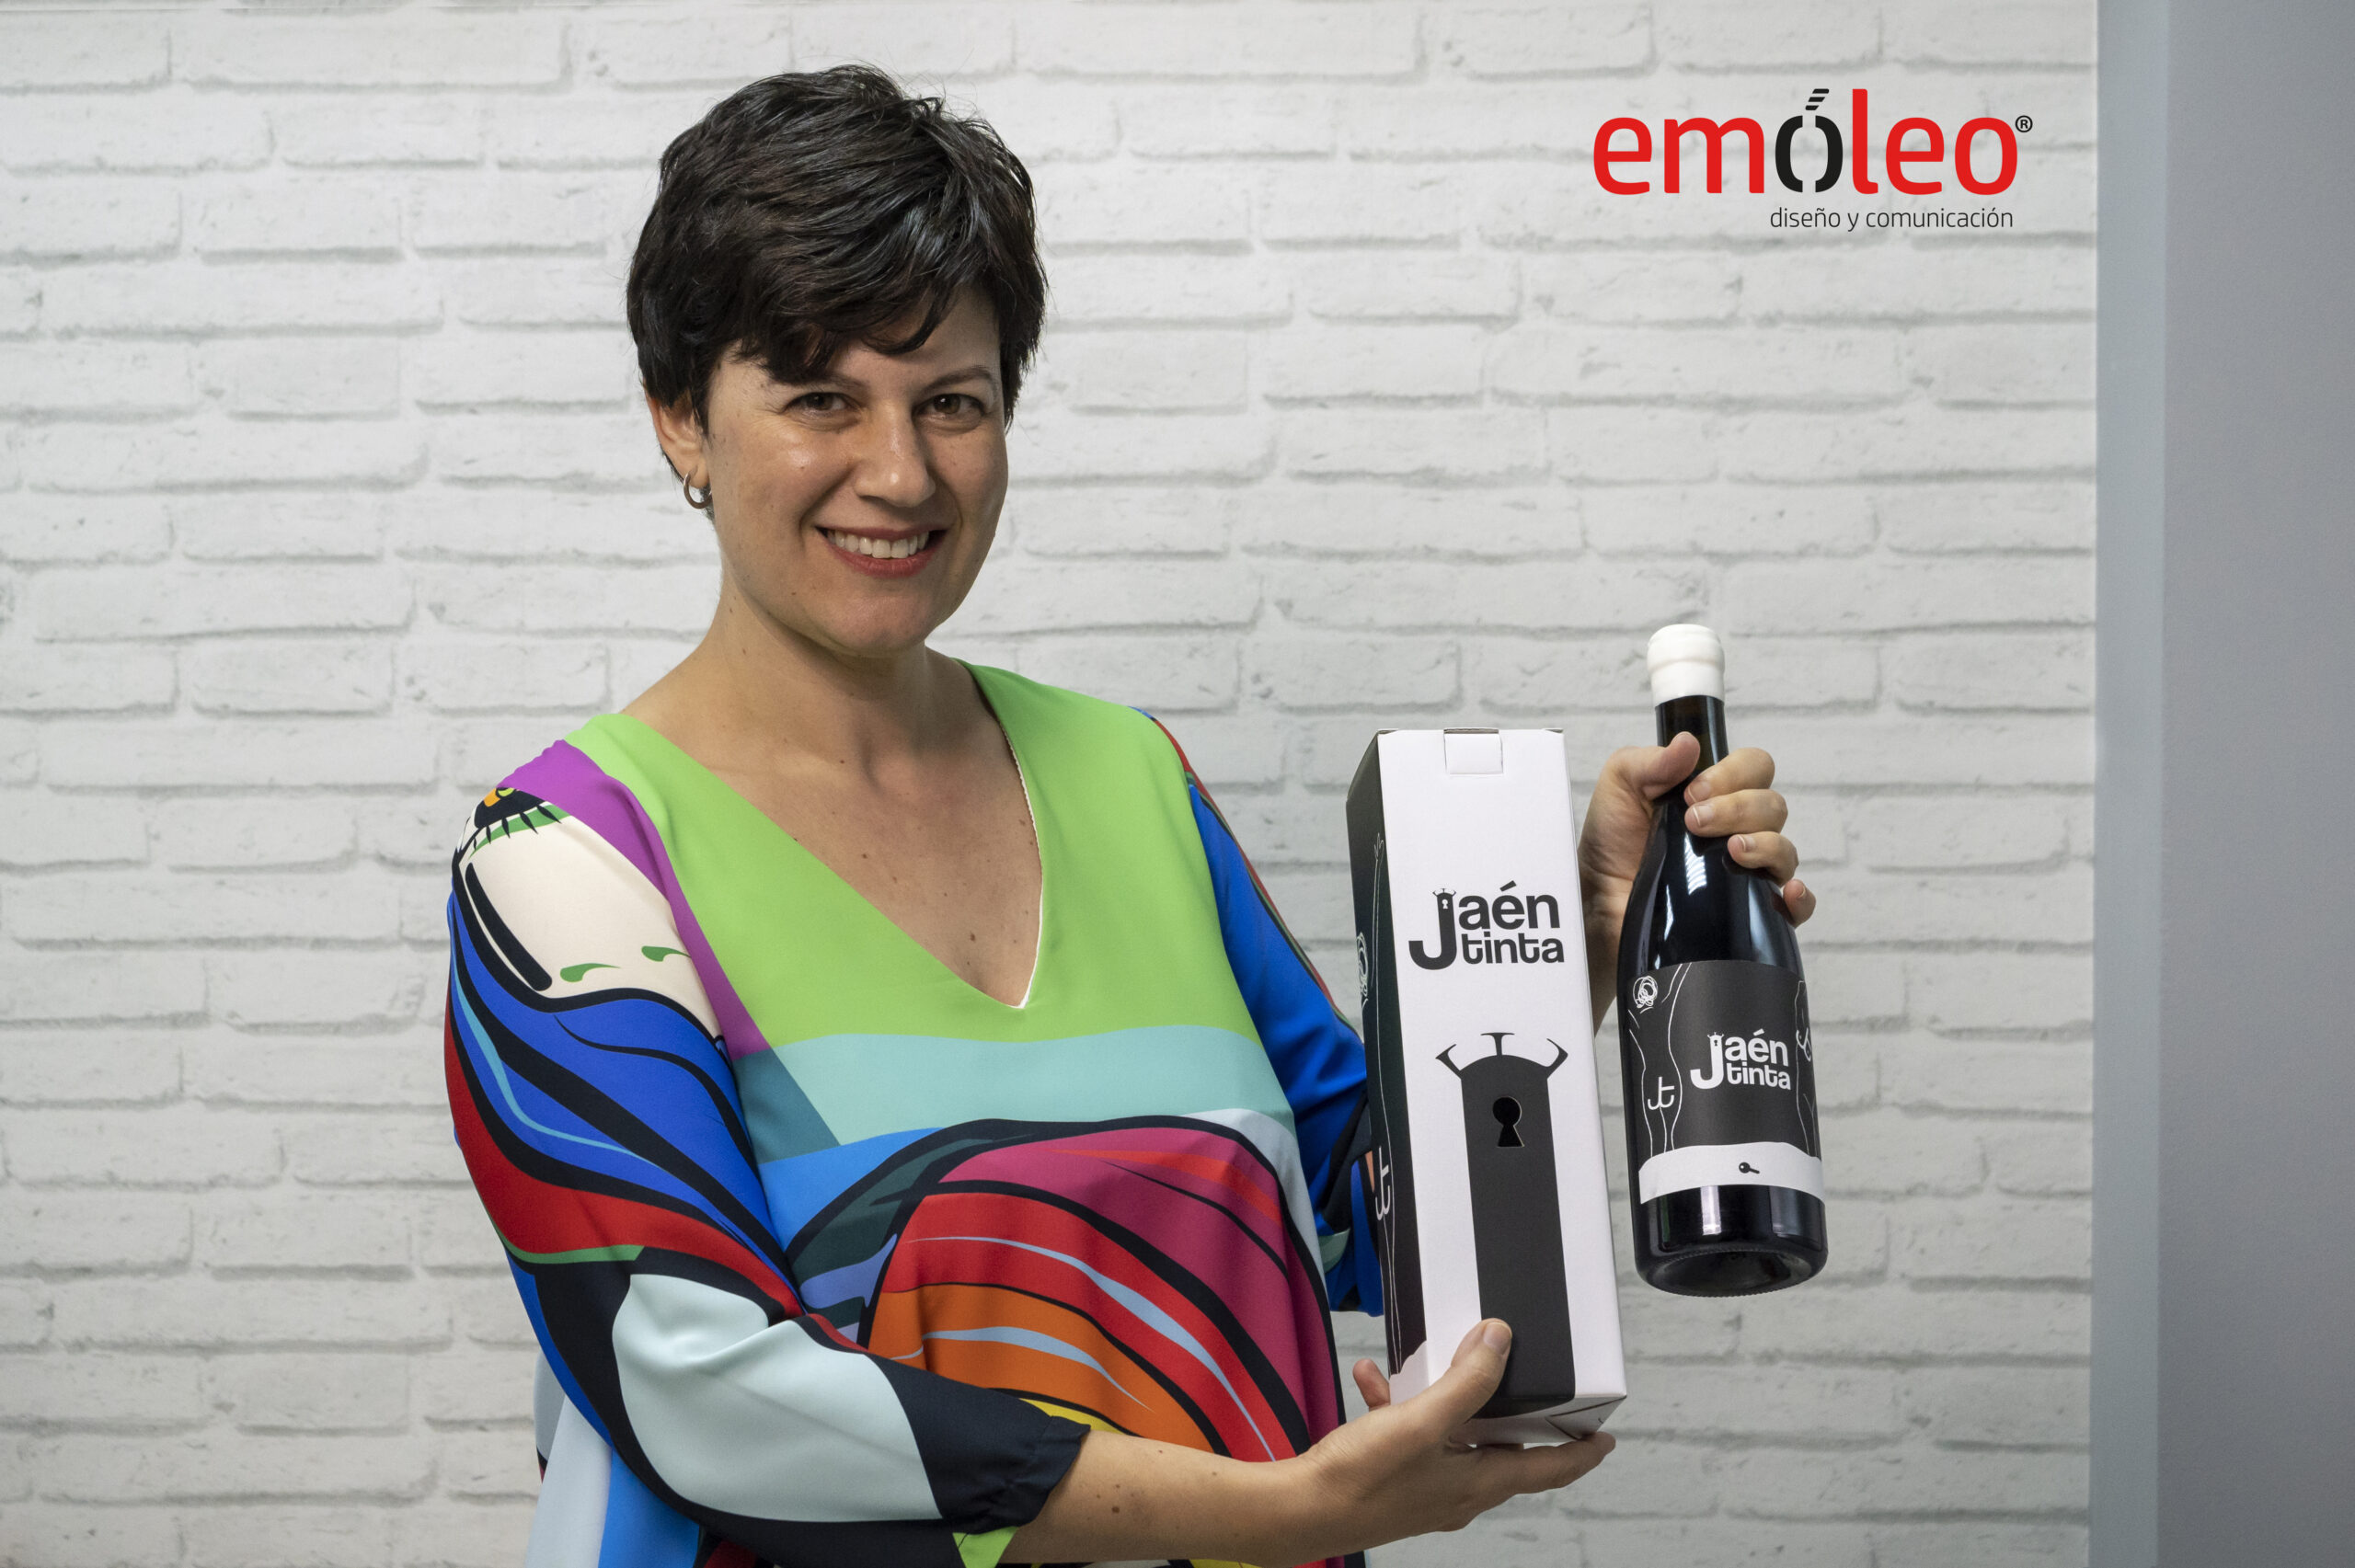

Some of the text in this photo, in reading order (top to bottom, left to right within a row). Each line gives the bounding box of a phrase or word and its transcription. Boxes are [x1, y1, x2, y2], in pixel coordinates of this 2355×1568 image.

[1408, 880, 1560, 970] Jaén
[1461, 932, 1564, 965] tinta
[1726, 1061, 1791, 1091] tinta
